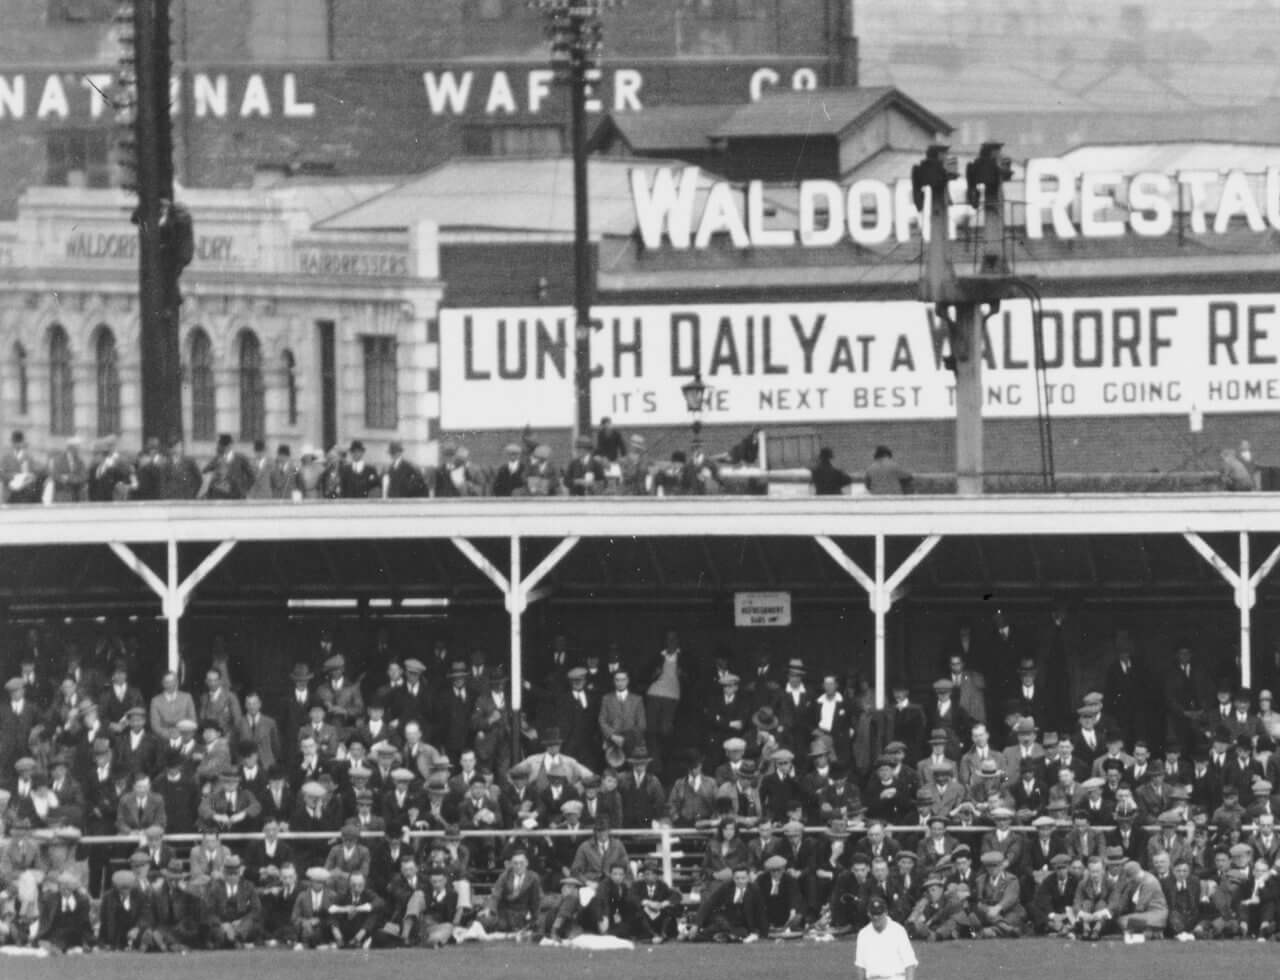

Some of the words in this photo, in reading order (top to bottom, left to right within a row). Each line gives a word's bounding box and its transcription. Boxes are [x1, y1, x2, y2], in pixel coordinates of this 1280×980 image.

[0, 74, 316, 118] NATNAL
[669, 312, 827, 376] DAILY
[829, 335, 876, 374] AT
[890, 333, 915, 373] A
[612, 391, 657, 413] IT'S
[692, 388, 729, 412] HE
[759, 386, 828, 411] NEXT
[853, 386, 922, 409] BEST
[945, 384, 1022, 406] TNG
[1045, 383, 1076, 404] TO
[1103, 381, 1181, 403] GOING
